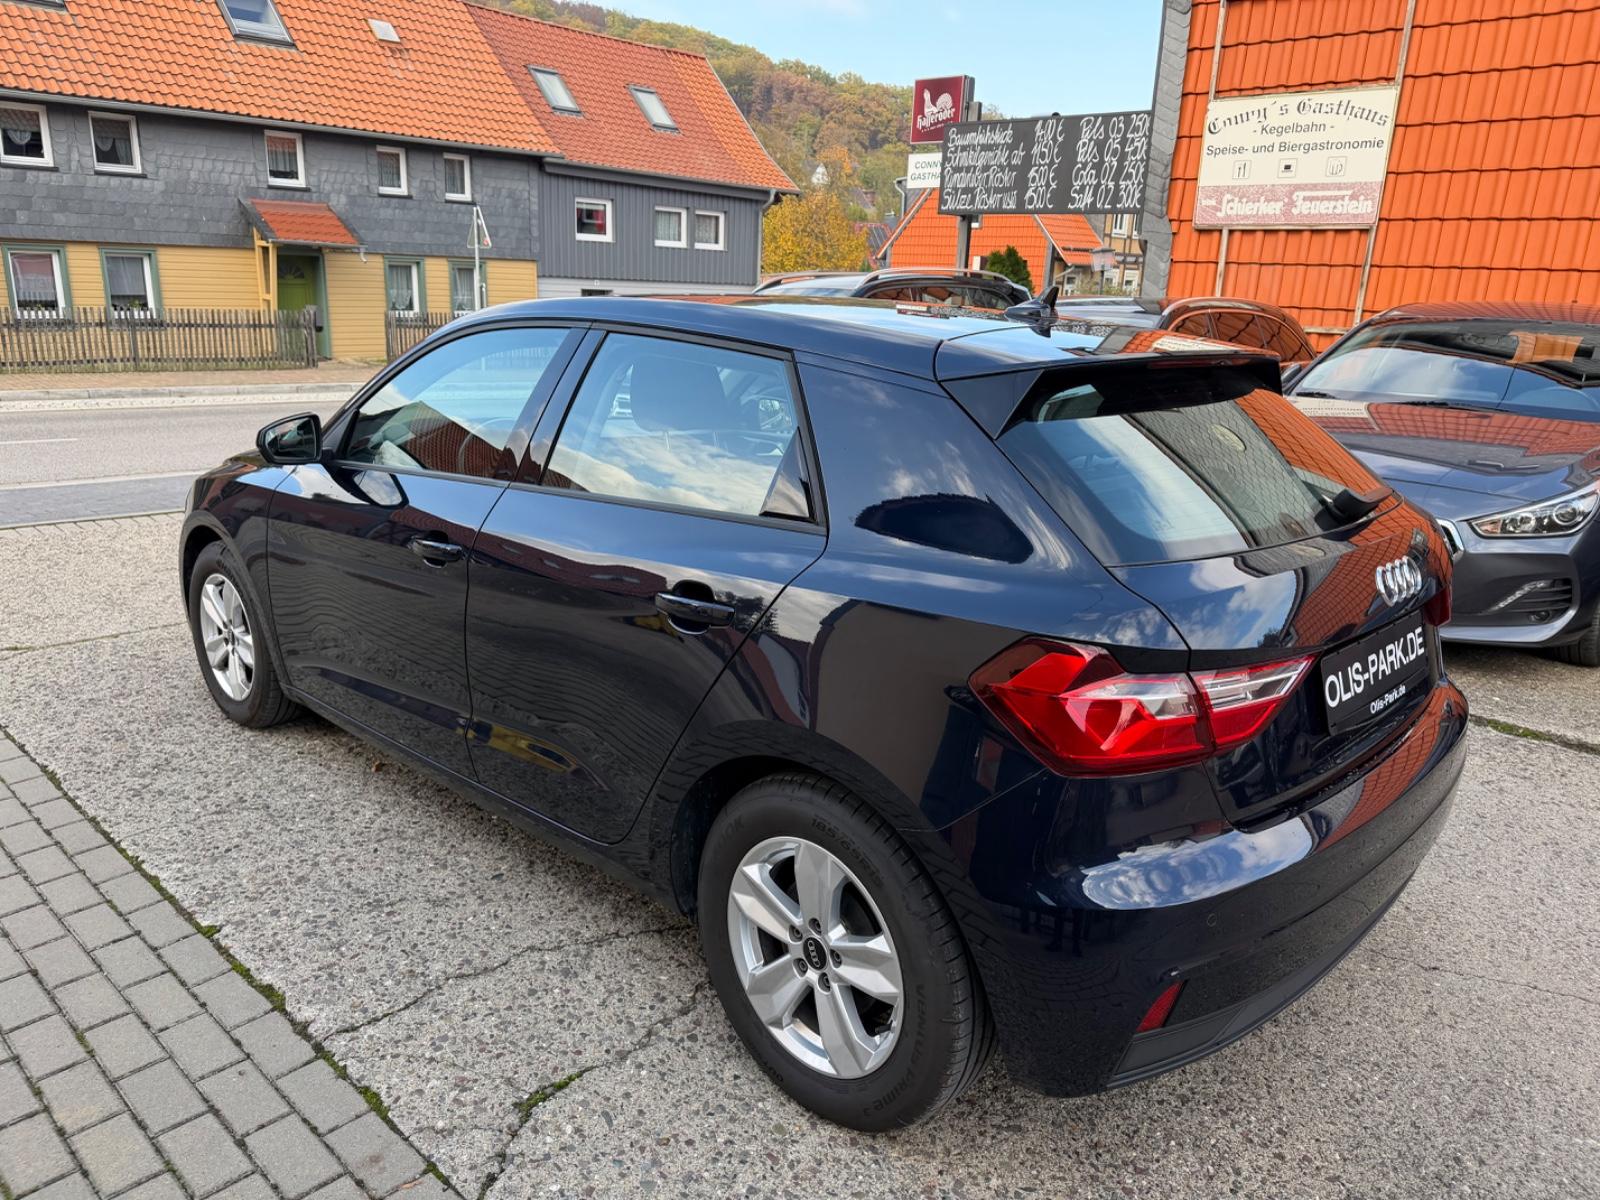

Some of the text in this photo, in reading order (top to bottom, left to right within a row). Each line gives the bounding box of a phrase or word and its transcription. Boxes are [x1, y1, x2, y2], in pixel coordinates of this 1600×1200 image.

[1297, 98, 1388, 126] Gasthaus
[1081, 116, 1104, 139] Pils
[1261, 121, 1326, 137] Kegelbahn
[1077, 139, 1100, 162] Pils
[1206, 136, 1385, 158] Speise- und Biergastronomie
[1072, 162, 1098, 186] Cola
[1069, 185, 1094, 210] Saft
[1216, 190, 1373, 217] Schierker Feuerstein
[1325, 626, 1425, 708] OLIS-PARK.DE
[1370, 685, 1406, 714] Olis-Park.de
